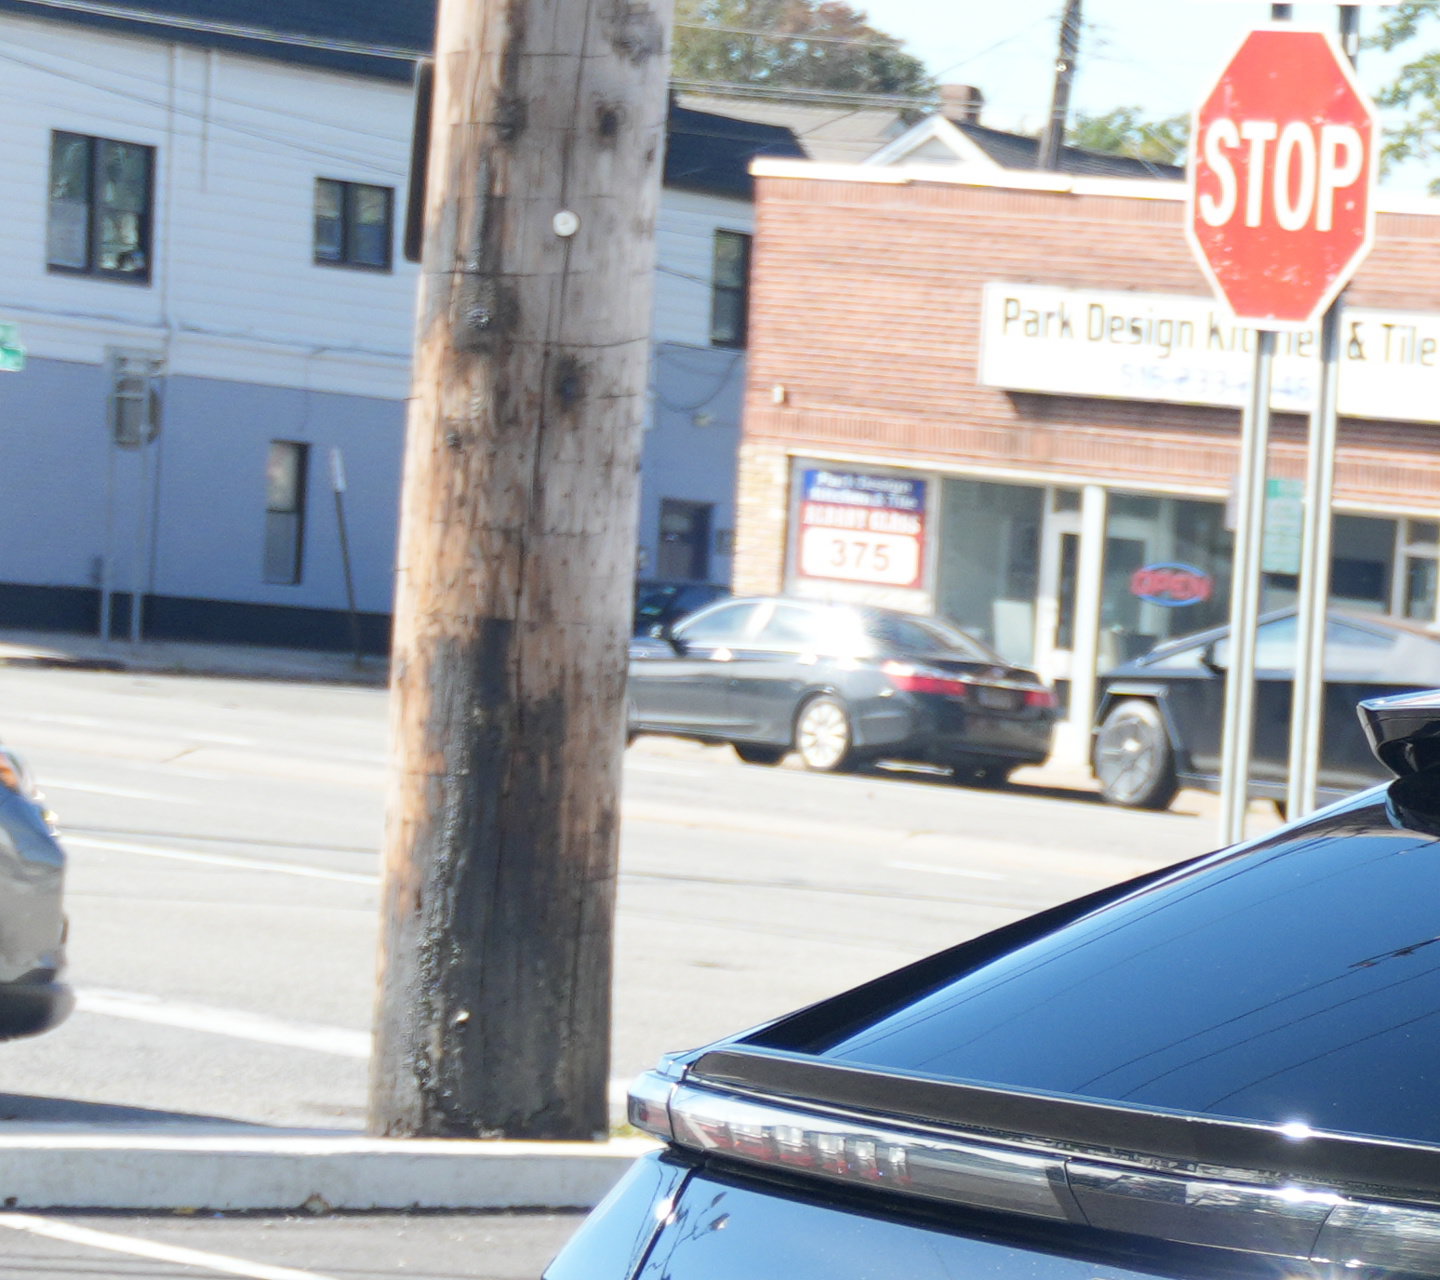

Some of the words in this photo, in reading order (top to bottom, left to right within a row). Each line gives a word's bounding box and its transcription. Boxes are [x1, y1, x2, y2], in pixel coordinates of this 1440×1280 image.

[1200, 118, 1364, 232] STOP
[1002, 297, 1074, 338] Park
[1088, 302, 1195, 359] Design
[1346, 320, 1367, 361] &
[1380, 322, 1437, 367] Tile
[832, 539, 889, 571] 375
